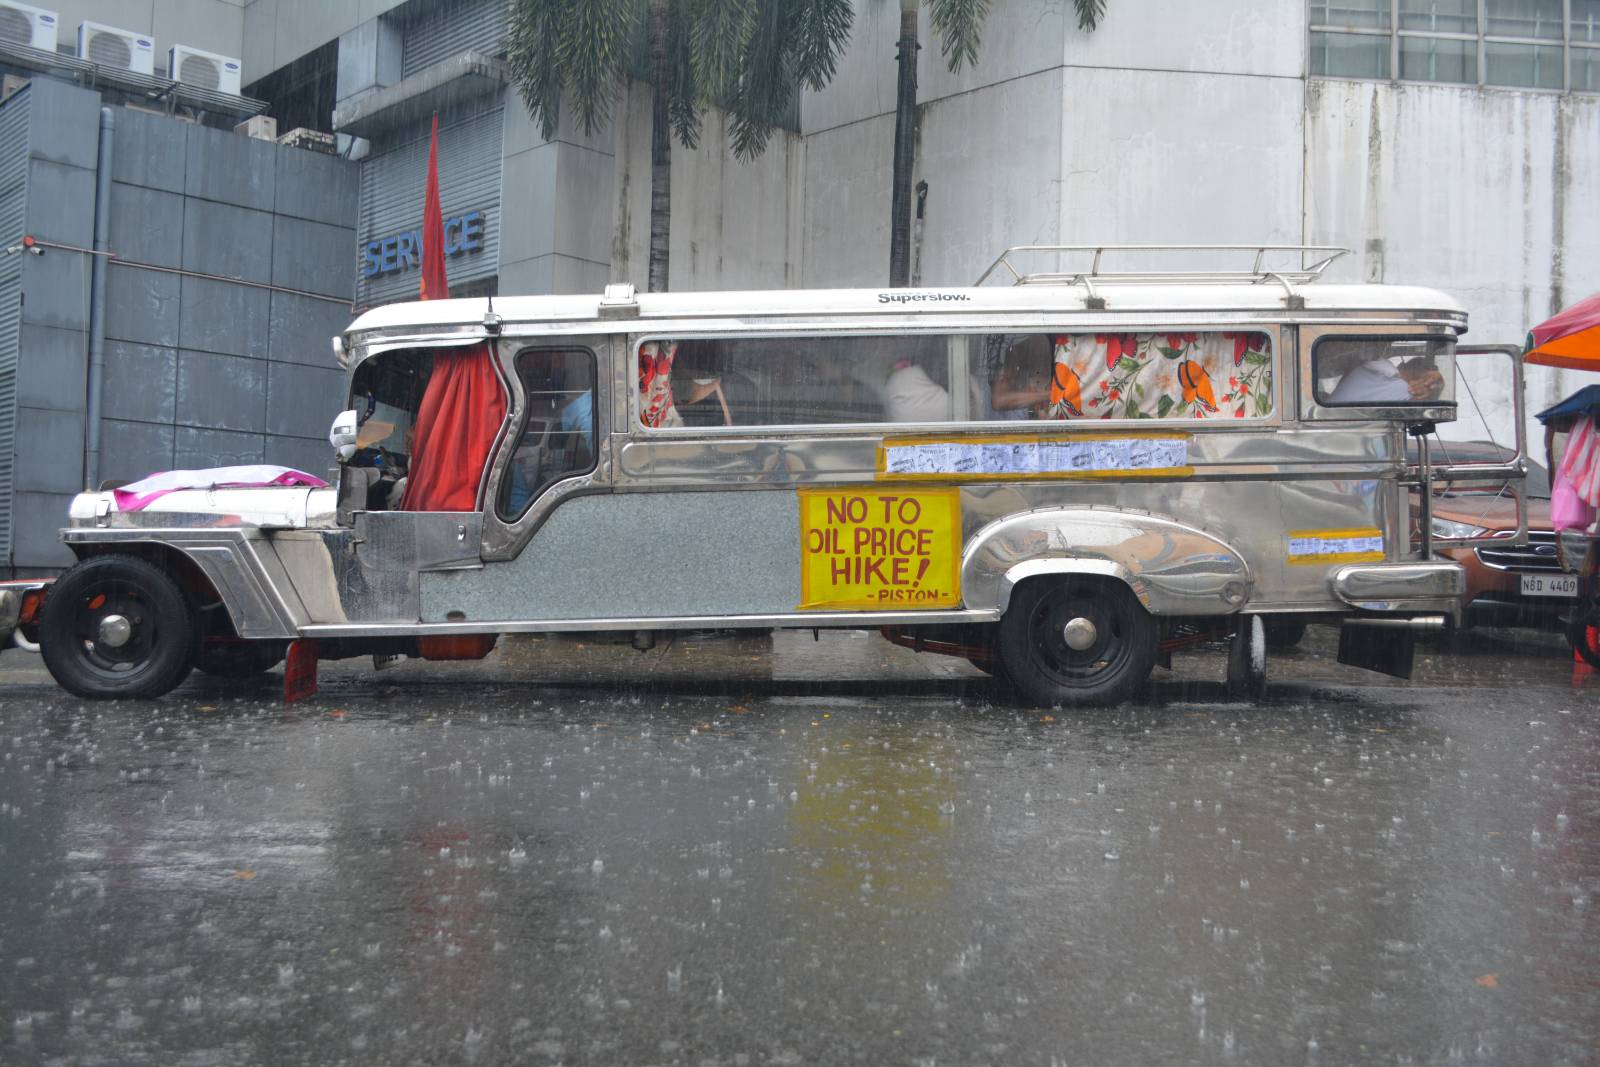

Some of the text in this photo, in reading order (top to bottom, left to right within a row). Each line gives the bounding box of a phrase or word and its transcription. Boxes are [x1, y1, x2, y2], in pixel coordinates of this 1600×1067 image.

[363, 210, 484, 278] SERCE
[877, 293, 971, 304] Superslow.
[827, 496, 921, 525] NO TO
[807, 527, 934, 556] OIL PRICE
[831, 556, 930, 588] HIKE!
[1523, 579, 1576, 592] NBD 4409
